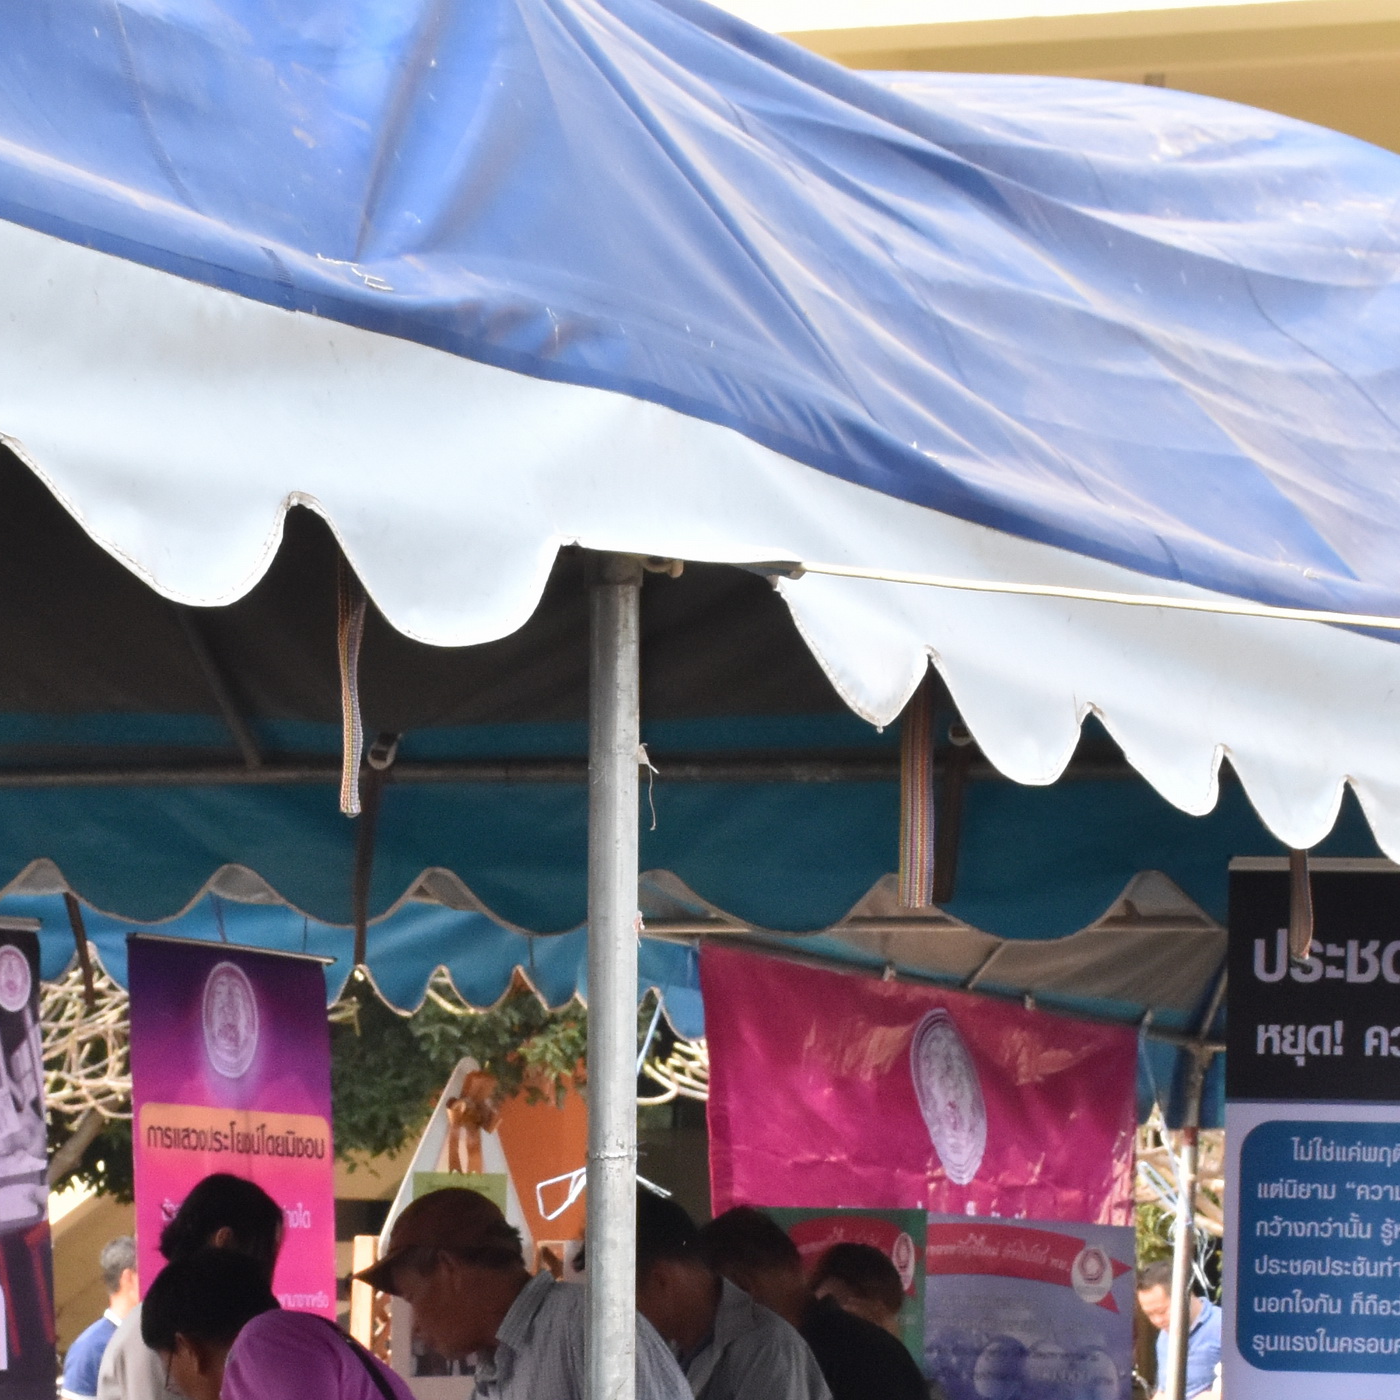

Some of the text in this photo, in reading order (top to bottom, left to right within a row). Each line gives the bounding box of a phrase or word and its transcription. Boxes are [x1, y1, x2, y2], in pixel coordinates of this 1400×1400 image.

[1257, 1020, 1344, 1065] หยุด!
[147, 1121, 325, 1159] การแสวงประโยชน์โดยมิชอบ
[1257, 1178, 1336, 1200] แต่นิยาม
[1255, 1213, 1372, 1239] กว้างกว่านั้น
[1253, 1289, 1342, 1314] นอกใจกัน
